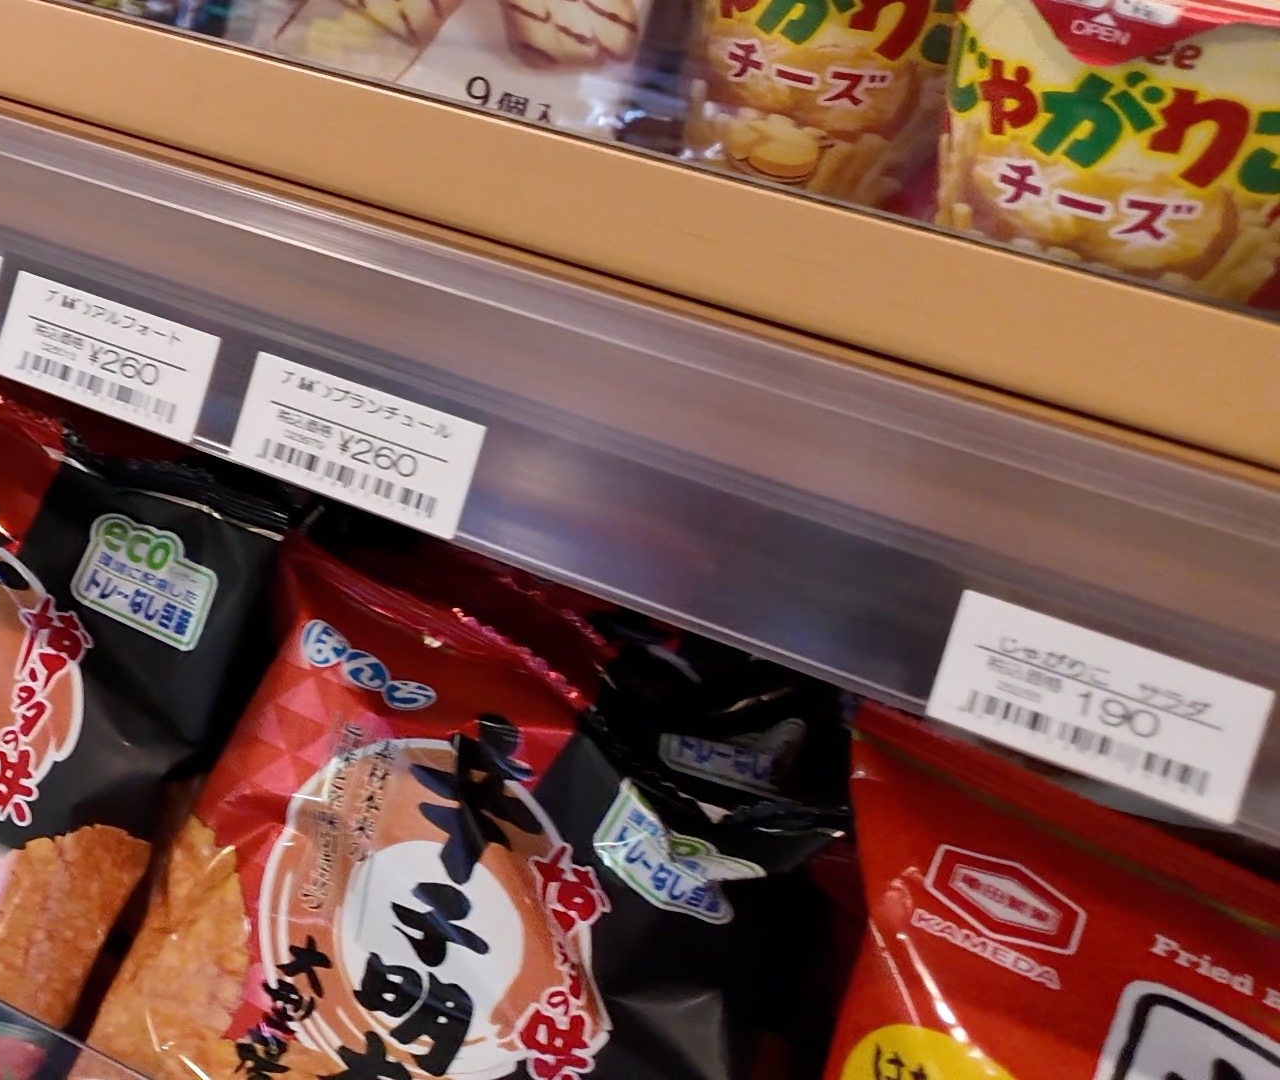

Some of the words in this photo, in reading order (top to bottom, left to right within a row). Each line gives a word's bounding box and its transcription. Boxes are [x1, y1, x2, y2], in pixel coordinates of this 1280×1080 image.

[1070, 19, 1131, 47] OPEN
[728, 41, 888, 107] チーズ
[998, 162, 1200, 242] チーズ
[84, 342, 161, 390] ¥260
[333, 429, 420, 483] ¥260
[102, 521, 172, 571] eco
[910, 908, 1062, 991] KAMEDA
[1149, 933, 1255, 996] Fried
